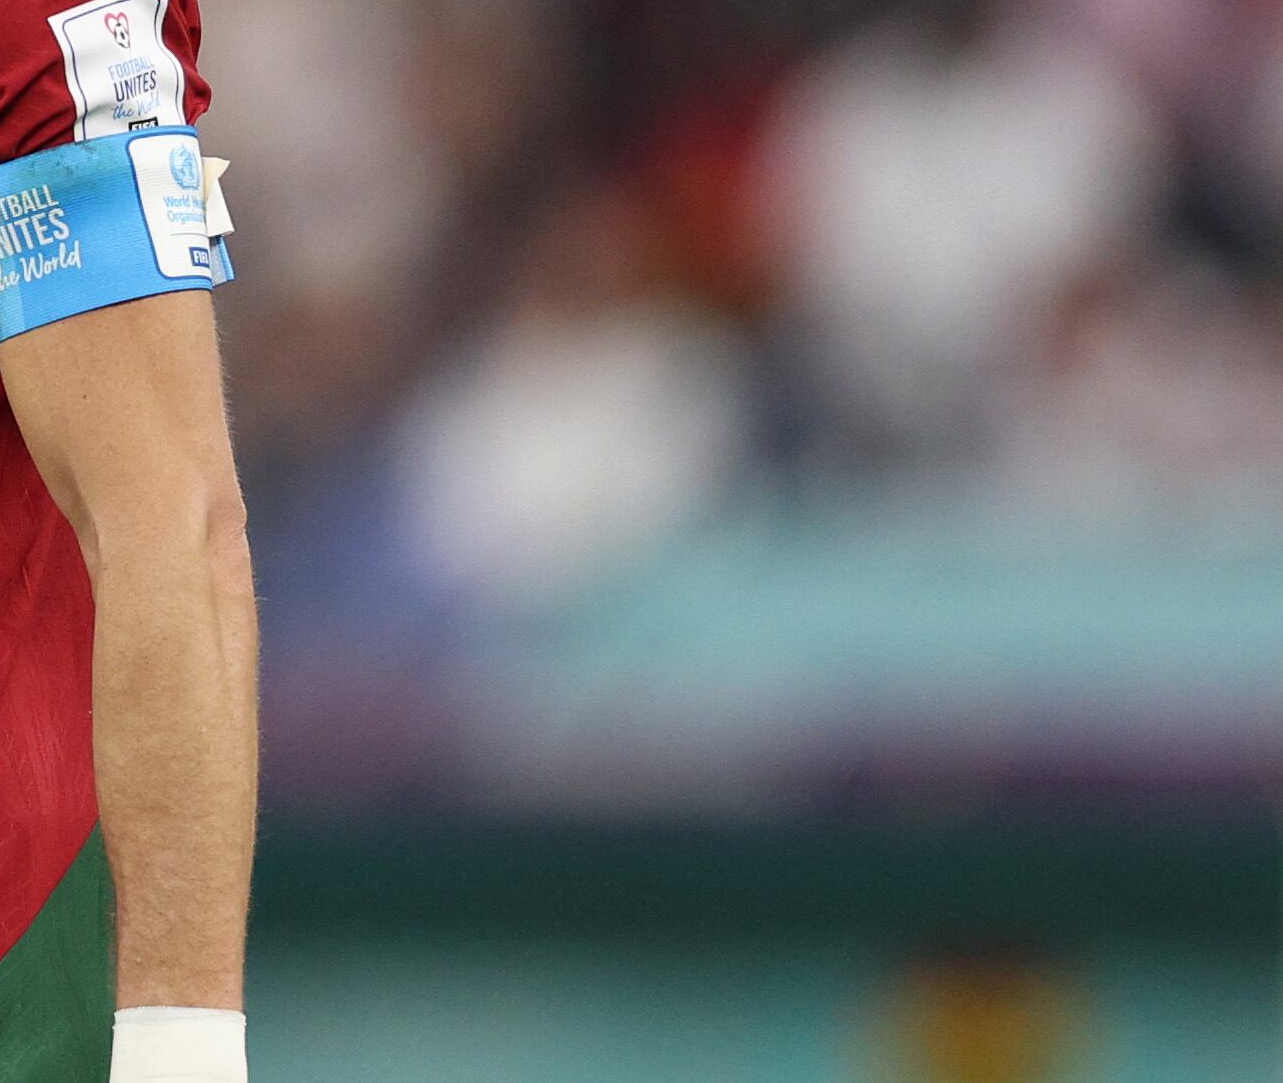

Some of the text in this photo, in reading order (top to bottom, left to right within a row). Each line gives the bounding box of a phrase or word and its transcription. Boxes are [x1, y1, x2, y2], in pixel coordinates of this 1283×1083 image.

[108, 55, 155, 80] FOOTBALL
[114, 70, 157, 102] UNITES
[112, 103, 135, 120] the
[163, 194, 190, 208] World
[19, 239, 82, 283] World
